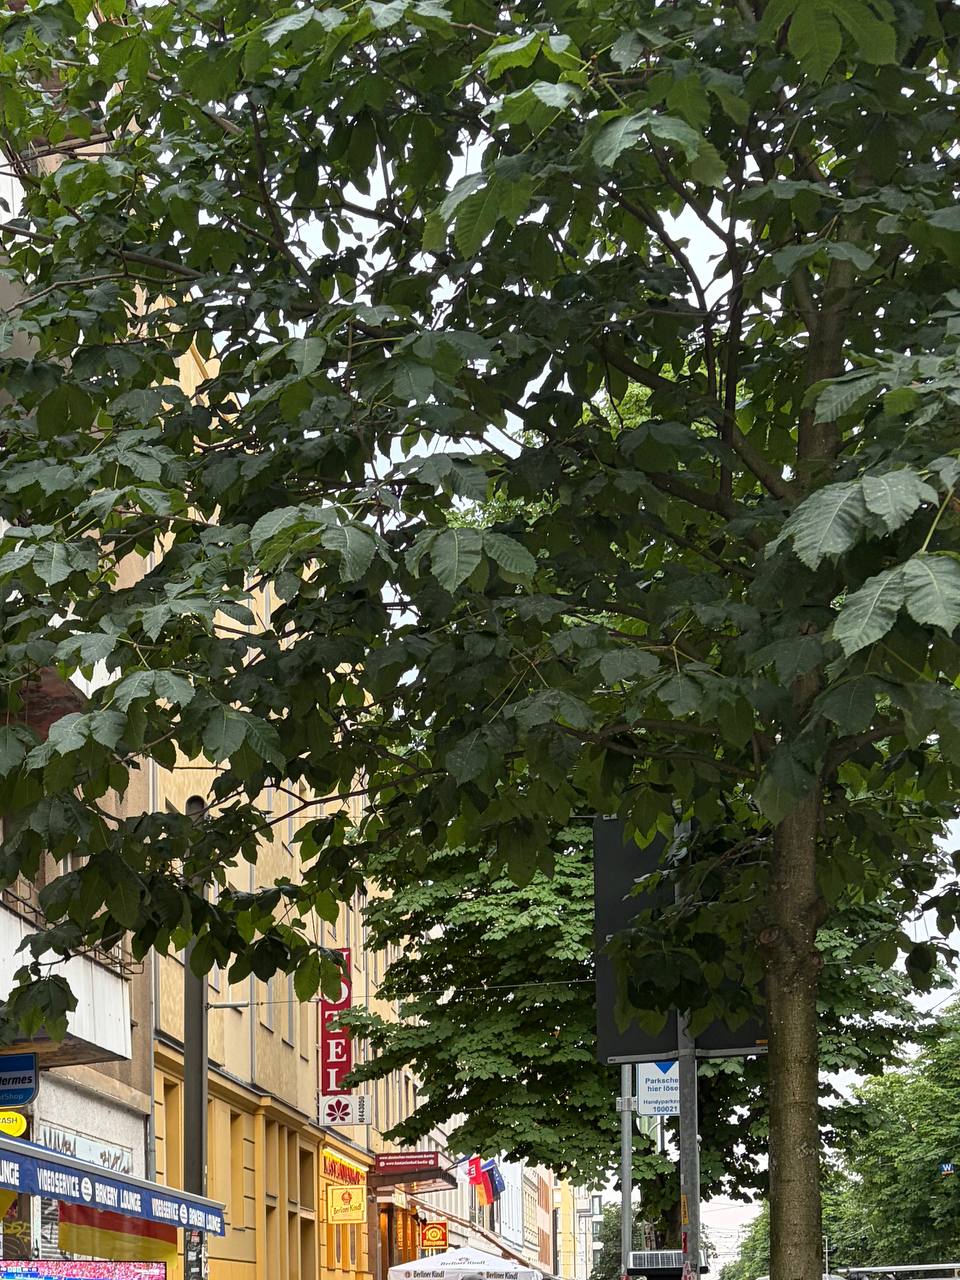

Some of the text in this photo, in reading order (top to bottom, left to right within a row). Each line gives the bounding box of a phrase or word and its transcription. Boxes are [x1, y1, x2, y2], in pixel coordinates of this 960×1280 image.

[645, 1077, 679, 1085] Parksche
[36, 1167, 80, 1198] VIDEOSERVICE
[95, 1182, 118, 1208] BAKERY
[119, 1189, 142, 1213] LOUNGE
[151, 1198, 179, 1221] VIDEOSERVICE
[188, 1207, 206, 1228] BAKERY
[206, 1213, 222, 1233] LOUNGE
[413, 1270, 445, 1278] Berliner Kindl
[486, 1271, 519, 1280] Berliner Kindl
